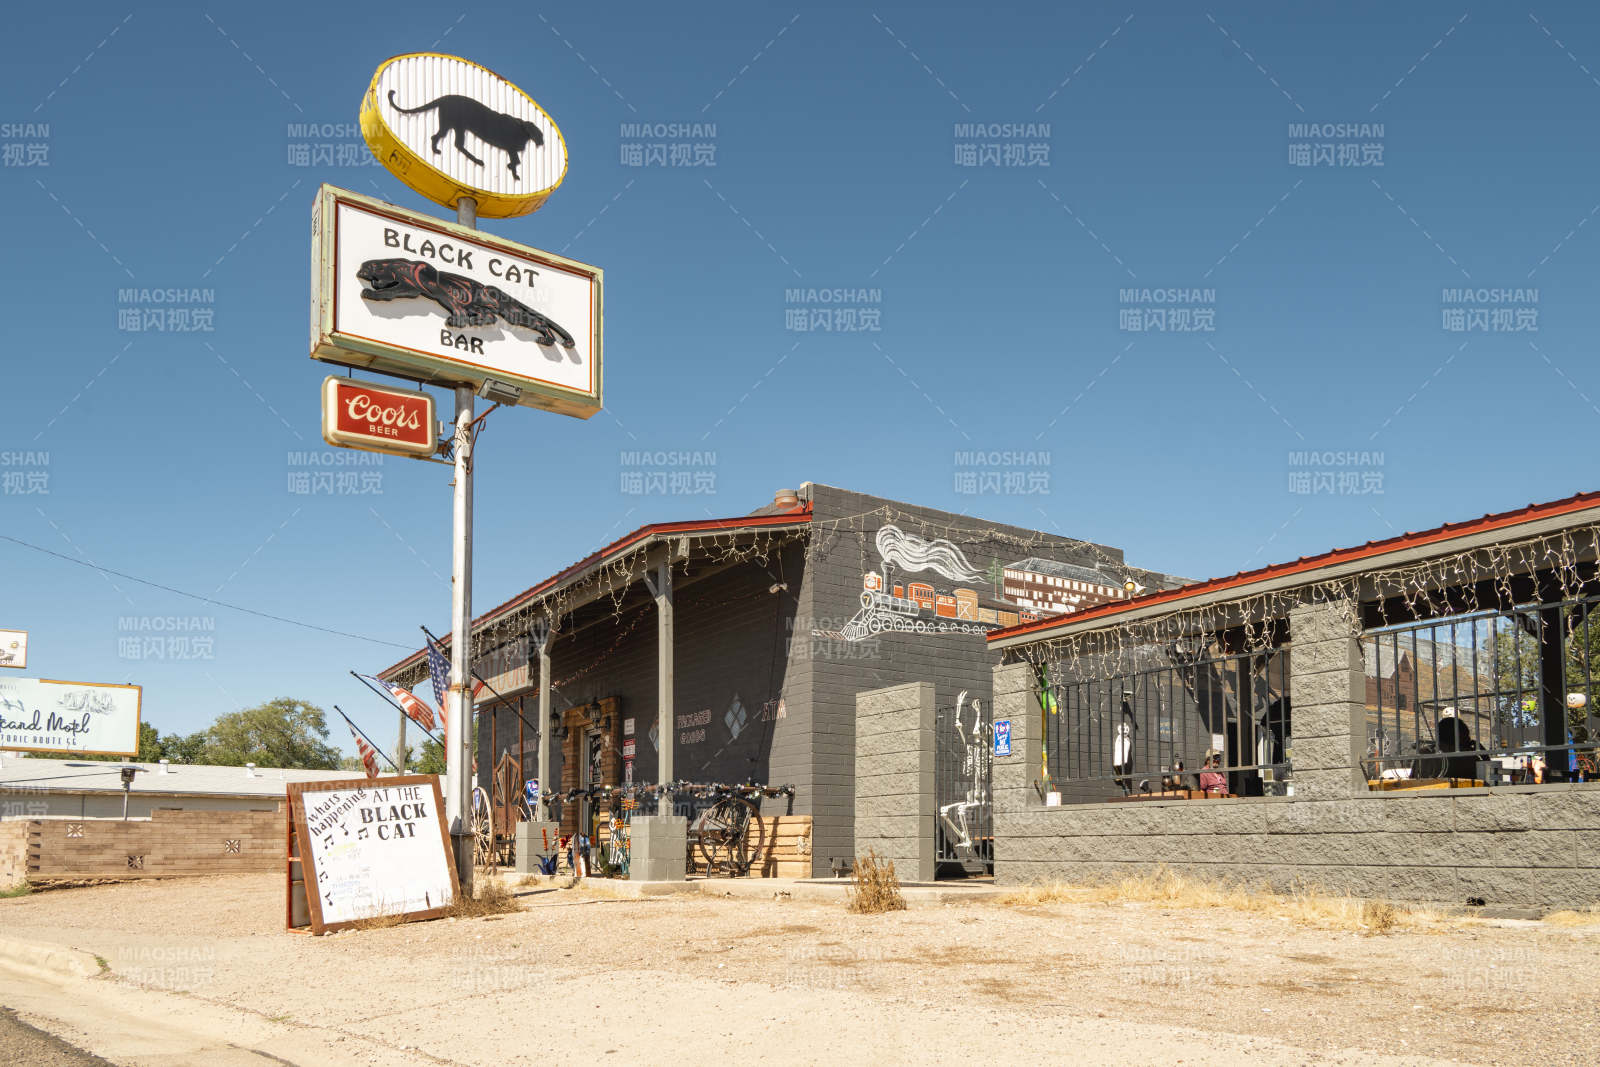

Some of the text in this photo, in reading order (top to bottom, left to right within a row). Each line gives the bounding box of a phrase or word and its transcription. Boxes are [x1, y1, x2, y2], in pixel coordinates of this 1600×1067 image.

[383, 227, 540, 288] BLACK CAT
[440, 329, 485, 355] BAR
[345, 394, 421, 430] Coors
[369, 425, 398, 436] BEER
[863, 595, 871, 606] 7
[761, 696, 787, 722] ATM
[33, 735, 62, 745] ROUTE
[373, 787, 423, 803] AT THE
[308, 793, 341, 822] whats
[310, 787, 367, 837] happening
[360, 803, 427, 824] BLACK
[378, 822, 416, 840] CAT
